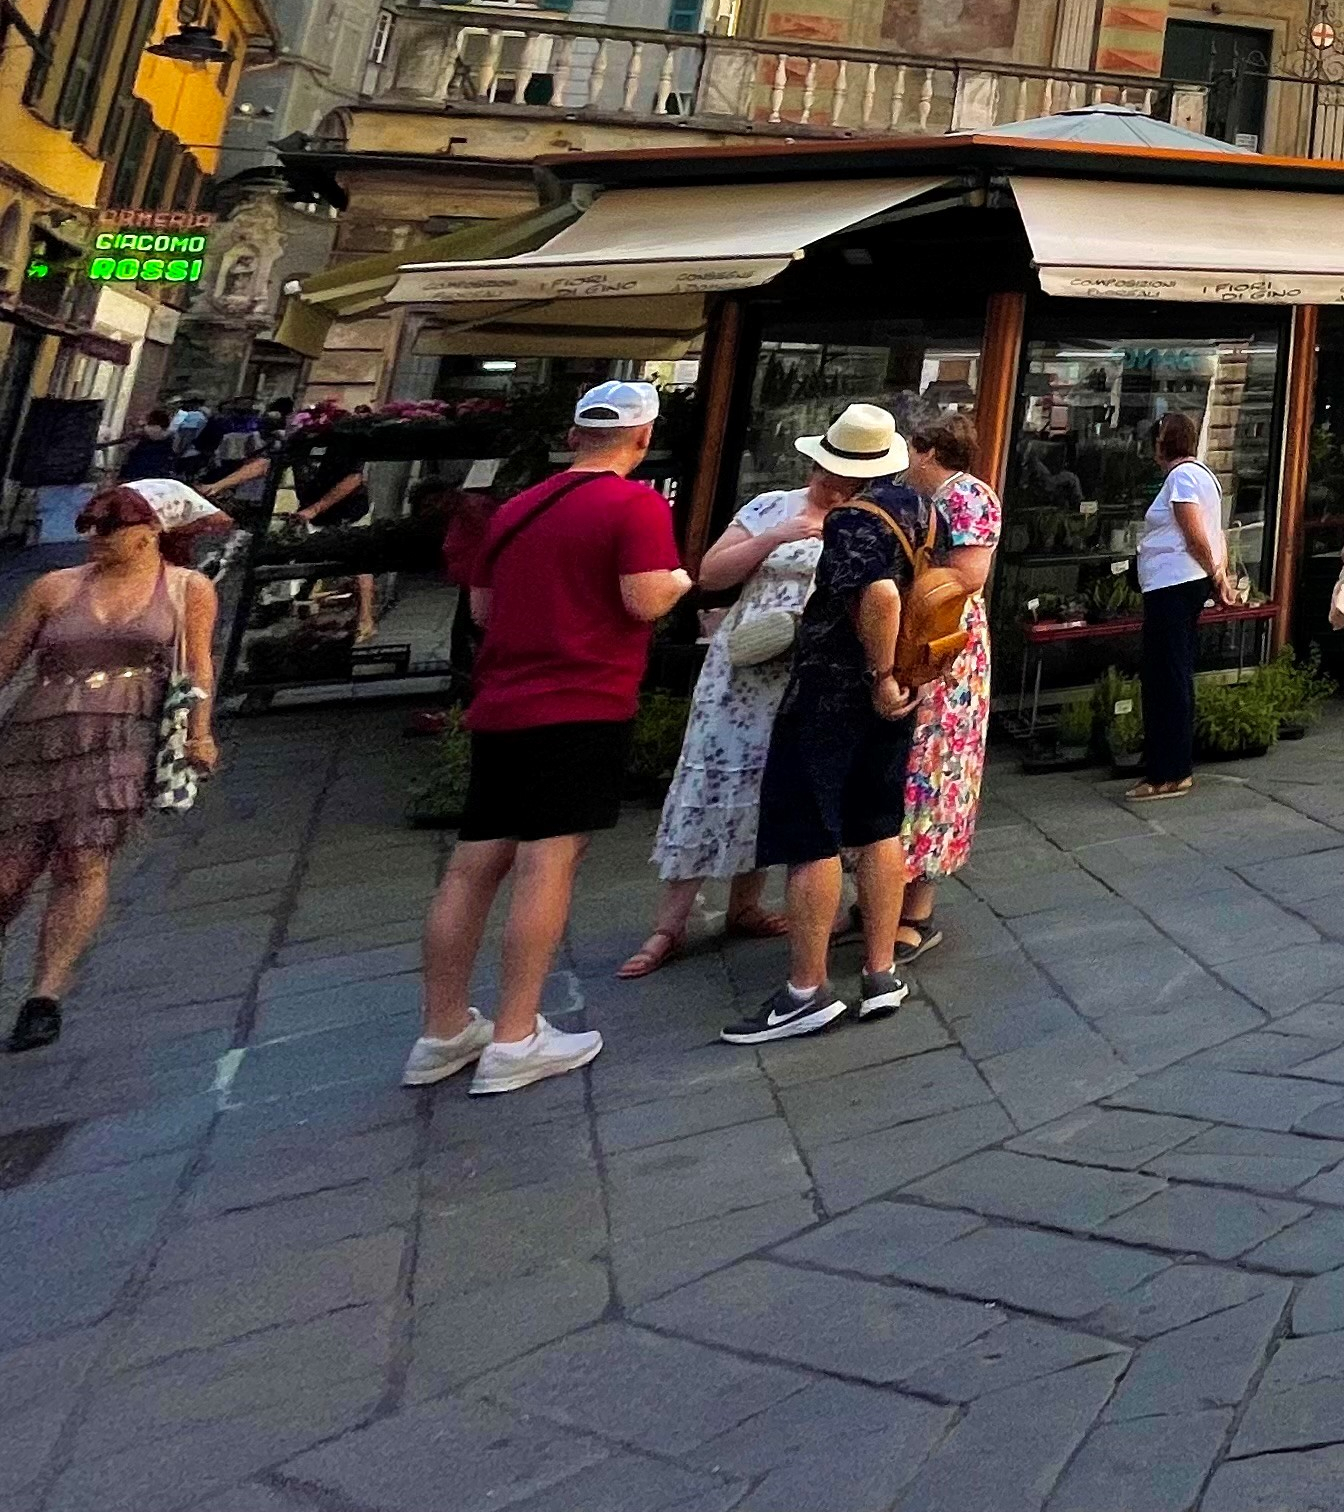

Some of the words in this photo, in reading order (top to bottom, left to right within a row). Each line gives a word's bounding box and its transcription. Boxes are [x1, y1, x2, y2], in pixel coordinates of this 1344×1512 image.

[95, 233, 206, 252] GIACOMO
[89, 257, 203, 282] ROSSI
[551, 275, 607, 287] FIORI
[1070, 277, 1177, 289] COMPOSIZIONI
[1215, 281, 1272, 293] FIORI
[1222, 292, 1243, 301] DI
[1250, 288, 1302, 301] GINO
